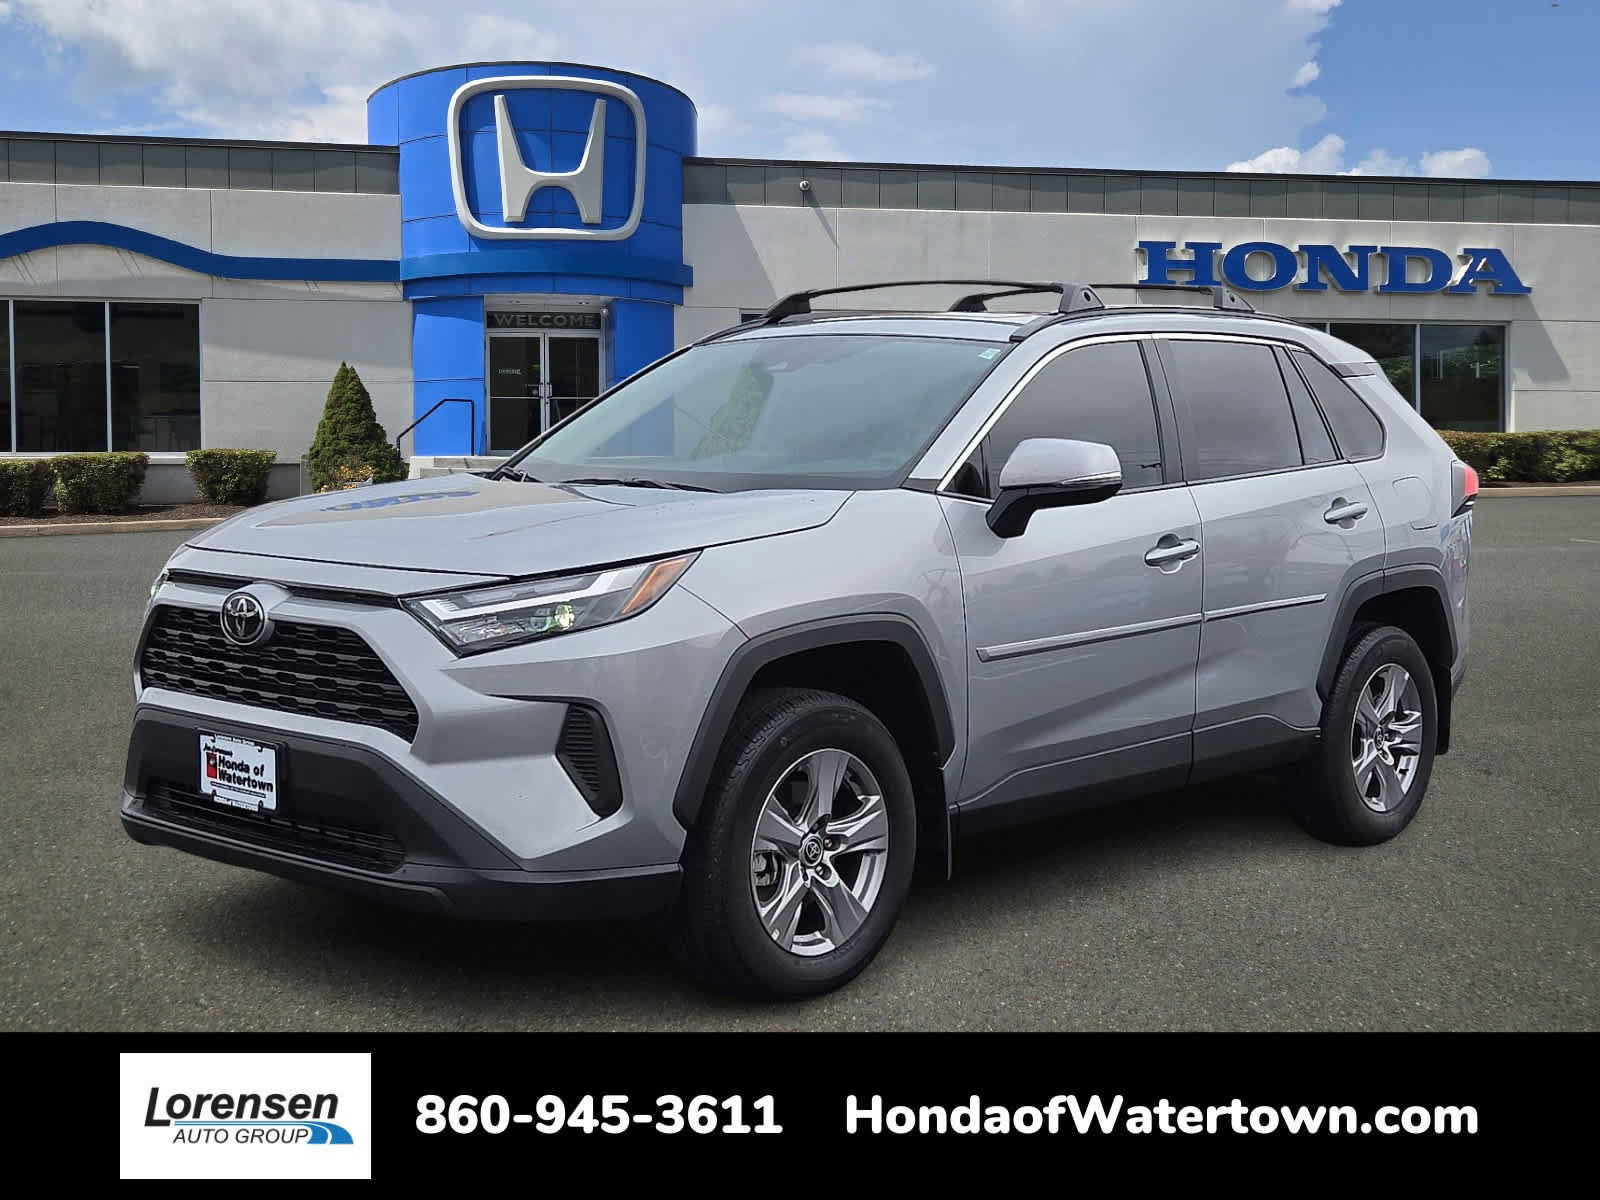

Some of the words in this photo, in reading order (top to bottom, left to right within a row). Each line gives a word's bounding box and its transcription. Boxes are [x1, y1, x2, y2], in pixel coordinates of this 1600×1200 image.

[1138, 241, 1531, 294] HONDA
[493, 313, 596, 328] WELCOME
[218, 755, 250, 773] Honda
[253, 764, 264, 777] of
[218, 768, 273, 792] Watertown
